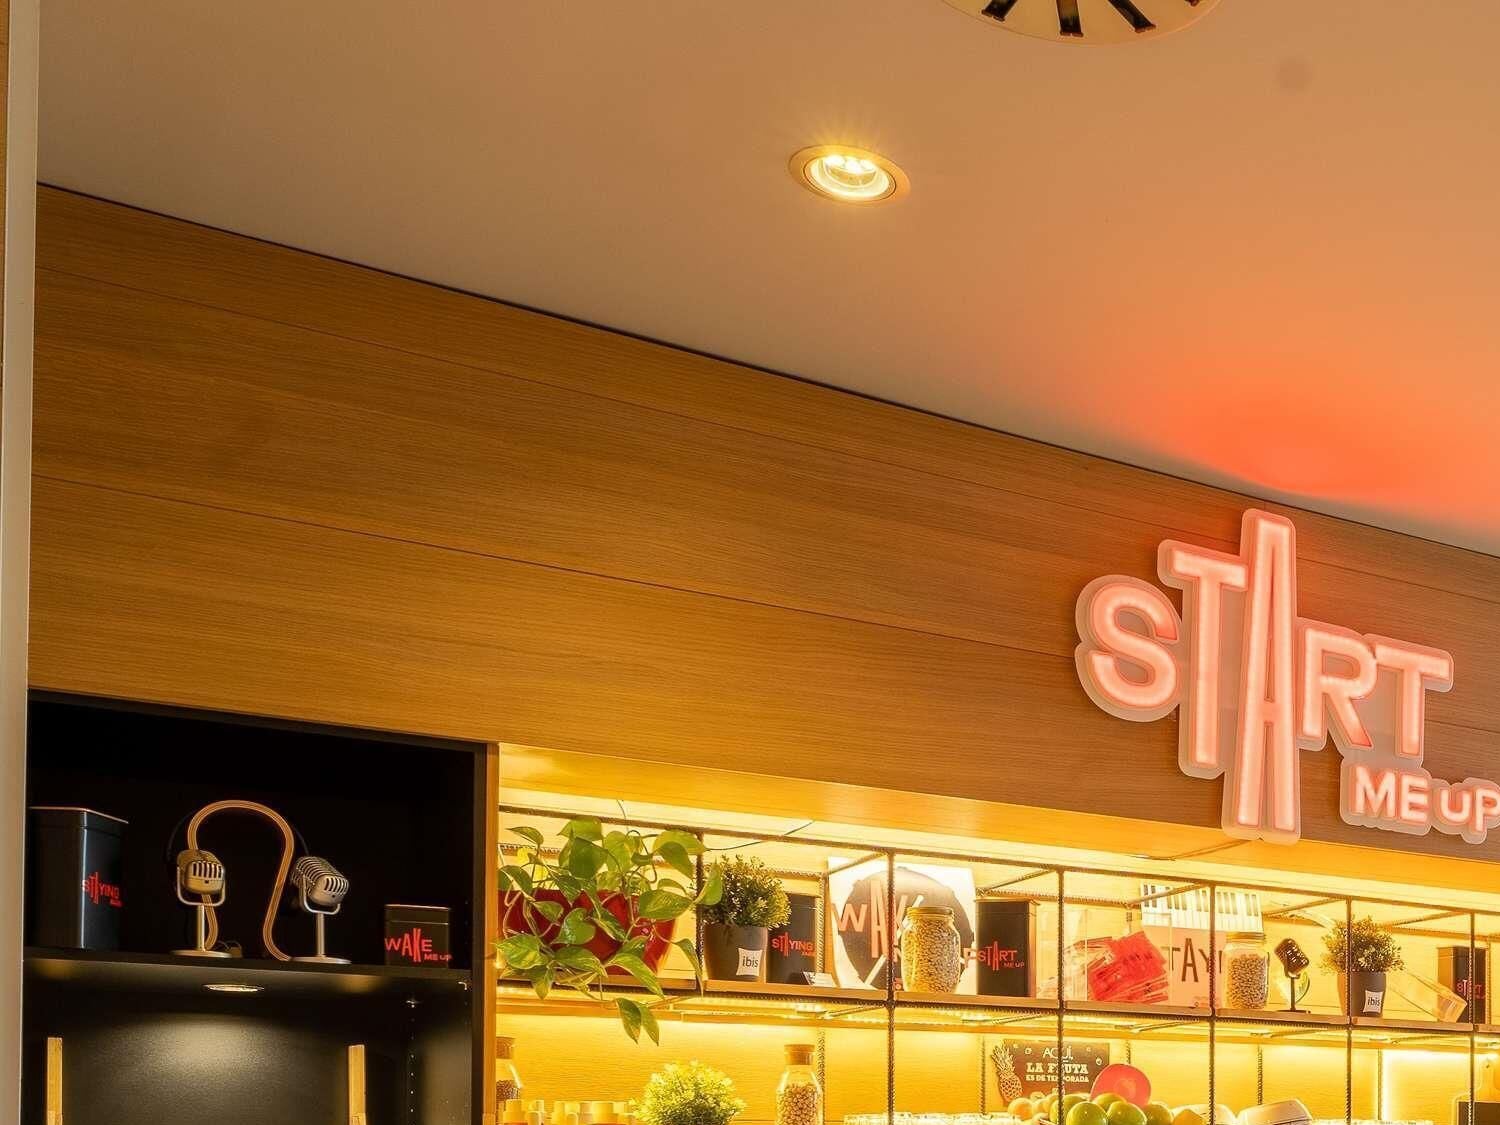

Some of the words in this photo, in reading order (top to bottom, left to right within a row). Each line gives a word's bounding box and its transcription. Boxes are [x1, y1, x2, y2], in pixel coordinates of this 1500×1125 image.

[1089, 516, 1452, 832] START
[1353, 765, 1429, 823] ME
[384, 927, 433, 963] WAKE
[976, 940, 1018, 971] START
[742, 955, 759, 968] ibis
[1367, 996, 1381, 1006] ibis
[1026, 1062, 1044, 1073] LA
[1047, 1062, 1089, 1075] FUTA
